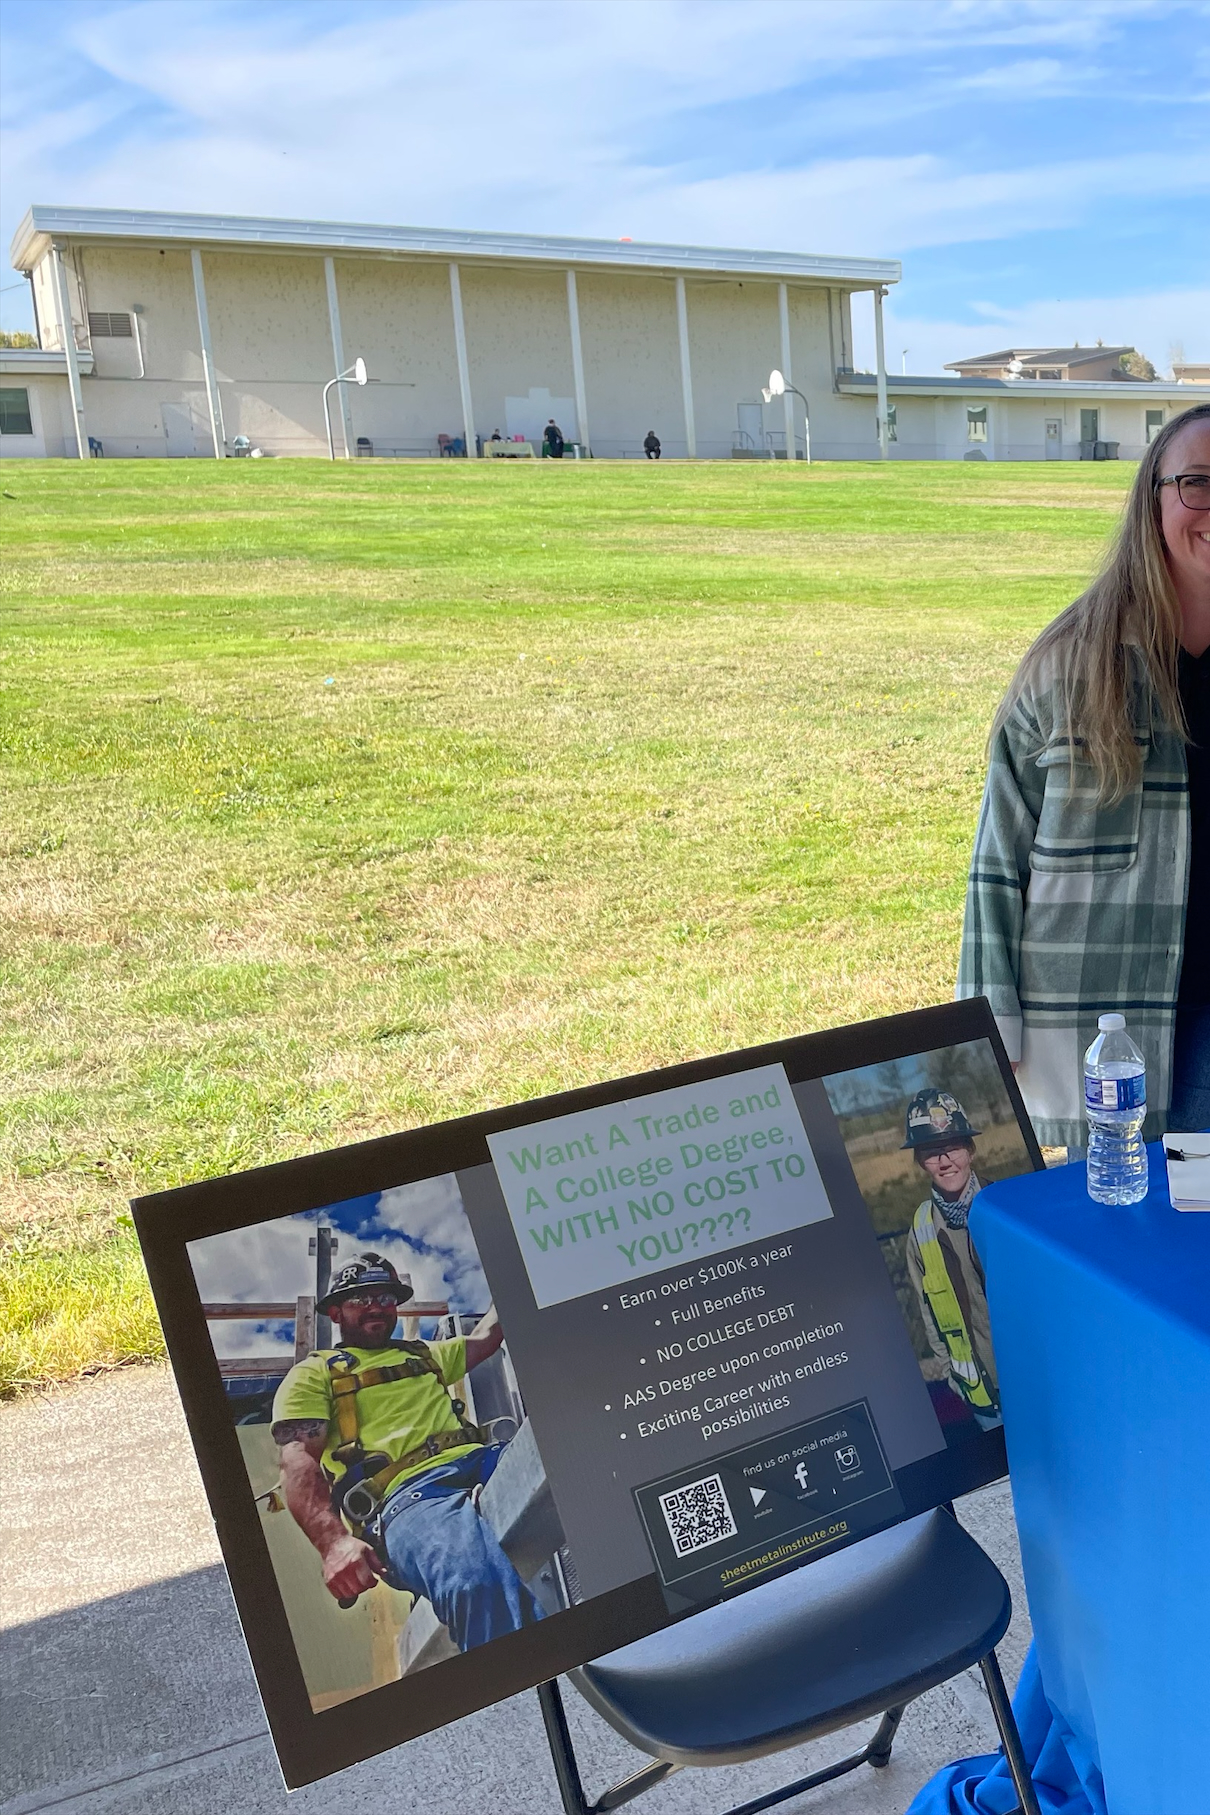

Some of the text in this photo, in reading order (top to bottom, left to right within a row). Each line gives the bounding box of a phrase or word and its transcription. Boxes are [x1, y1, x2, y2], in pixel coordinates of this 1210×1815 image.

[507, 1084, 781, 1174] Want A Trade and
[525, 1126, 794, 1214] A College Degree,
[528, 1154, 806, 1252] WITH NO COST TO
[616, 1207, 751, 1267] YOU????
[619, 1244, 793, 1310] Earn over $100K a year
[672, 1284, 766, 1325] Full Benefits
[623, 1320, 844, 1410] AAS Degree upon completion
[656, 1304, 796, 1363] NO COLLEGE DEBT
[638, 1350, 849, 1438] Exciting Career with endless
[701, 1394, 791, 1440] possibilities
[742, 1430, 848, 1477] find us on social media
[720, 1520, 848, 1582] sheetmetalinstitute.org
